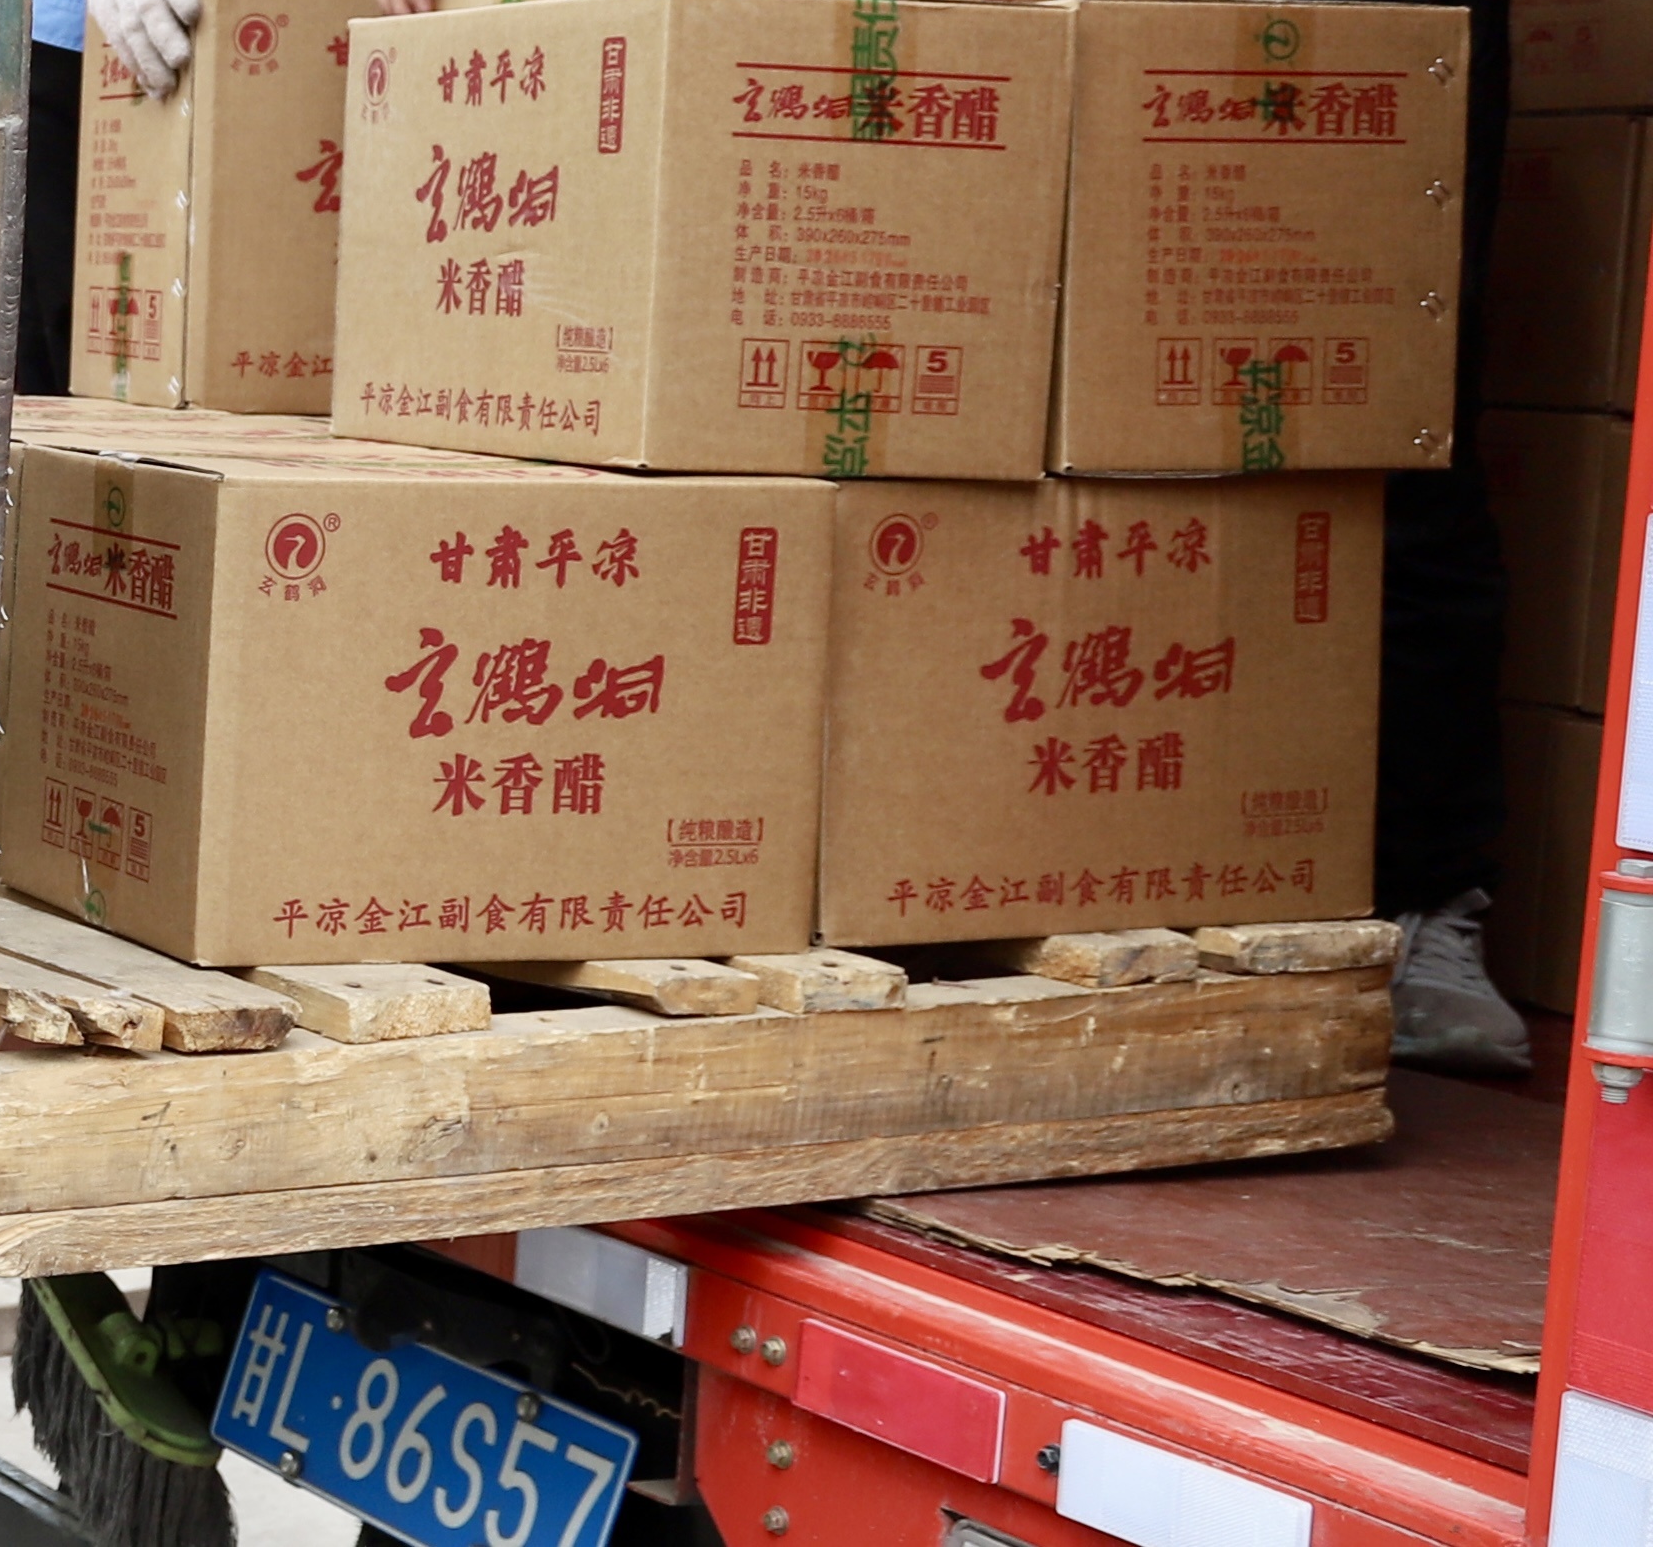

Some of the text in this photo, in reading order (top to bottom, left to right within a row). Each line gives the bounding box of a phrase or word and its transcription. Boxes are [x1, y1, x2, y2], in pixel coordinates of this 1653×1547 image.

[437, 45, 546, 107] 甘肃平凉
[436, 257, 525, 318] 米香醋
[359, 381, 601, 436] 平凉金江副食有限责任公司
[431, 523, 641, 589] 甘肃平凉
[1020, 517, 1213, 579] 甘肃平凉
[433, 752, 605, 816] 米香醋
[1027, 732, 1185, 796] 米香醋
[272, 890, 749, 939] 平凉金江副食有限责任公司
[888, 857, 1316, 917] 平凉金江副食有限责任公司
